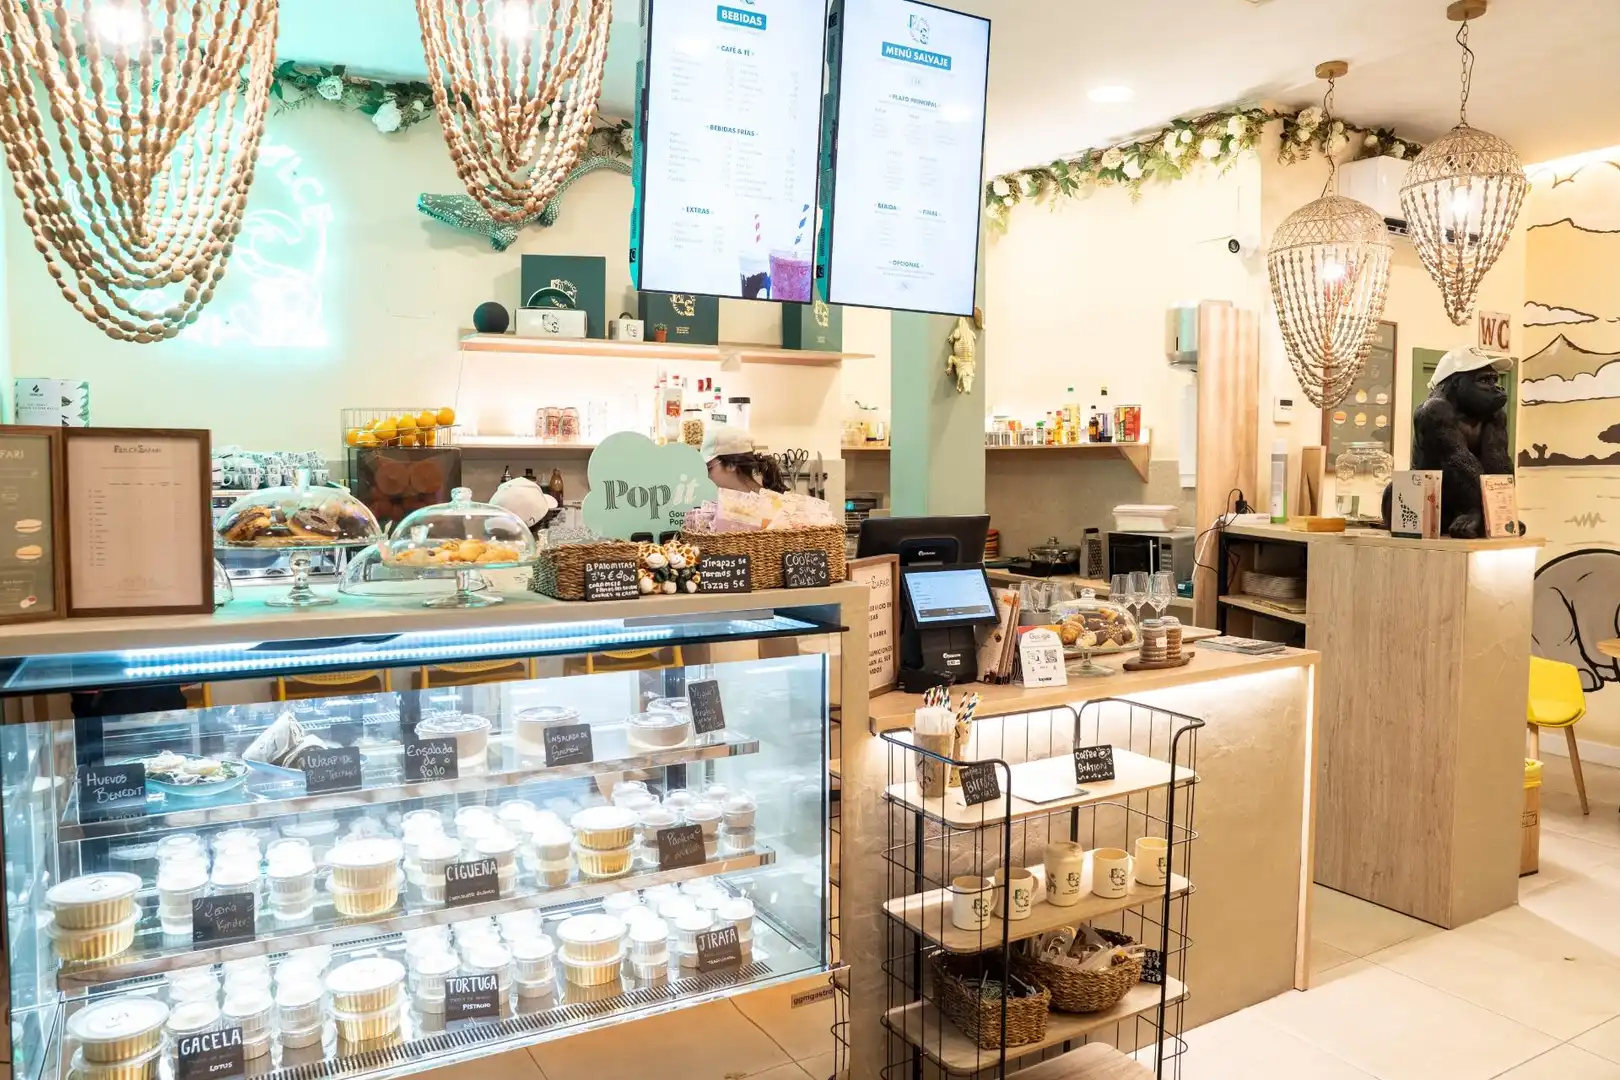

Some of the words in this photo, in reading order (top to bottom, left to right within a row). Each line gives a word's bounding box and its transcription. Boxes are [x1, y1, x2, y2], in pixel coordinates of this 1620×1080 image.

[721, 9, 763, 27] BEBIDAS
[721, 45, 737, 54] CAFÉ
[886, 45, 912, 59] MENÚ
[913, 50, 949, 67] SALVAJE
[892, 94, 910, 102] PLATO
[910, 98, 937, 108] PRINCIPAL
[709, 124, 737, 134] BEBIDAS
[737, 128, 755, 137] FRÍAS
[686, 206, 710, 215] EXTRAS
[923, 209, 938, 217] FINAL
[892, 260, 920, 268] OPCIONAL
[1480, 316, 1509, 349] WC
[701, 581, 729, 589] Tazas
[698, 928, 737, 951] JIRAFA
[446, 975, 498, 994] TORTUGA
[181, 1029, 242, 1056] GACELA
[209, 1061, 233, 1072] LOTUS
